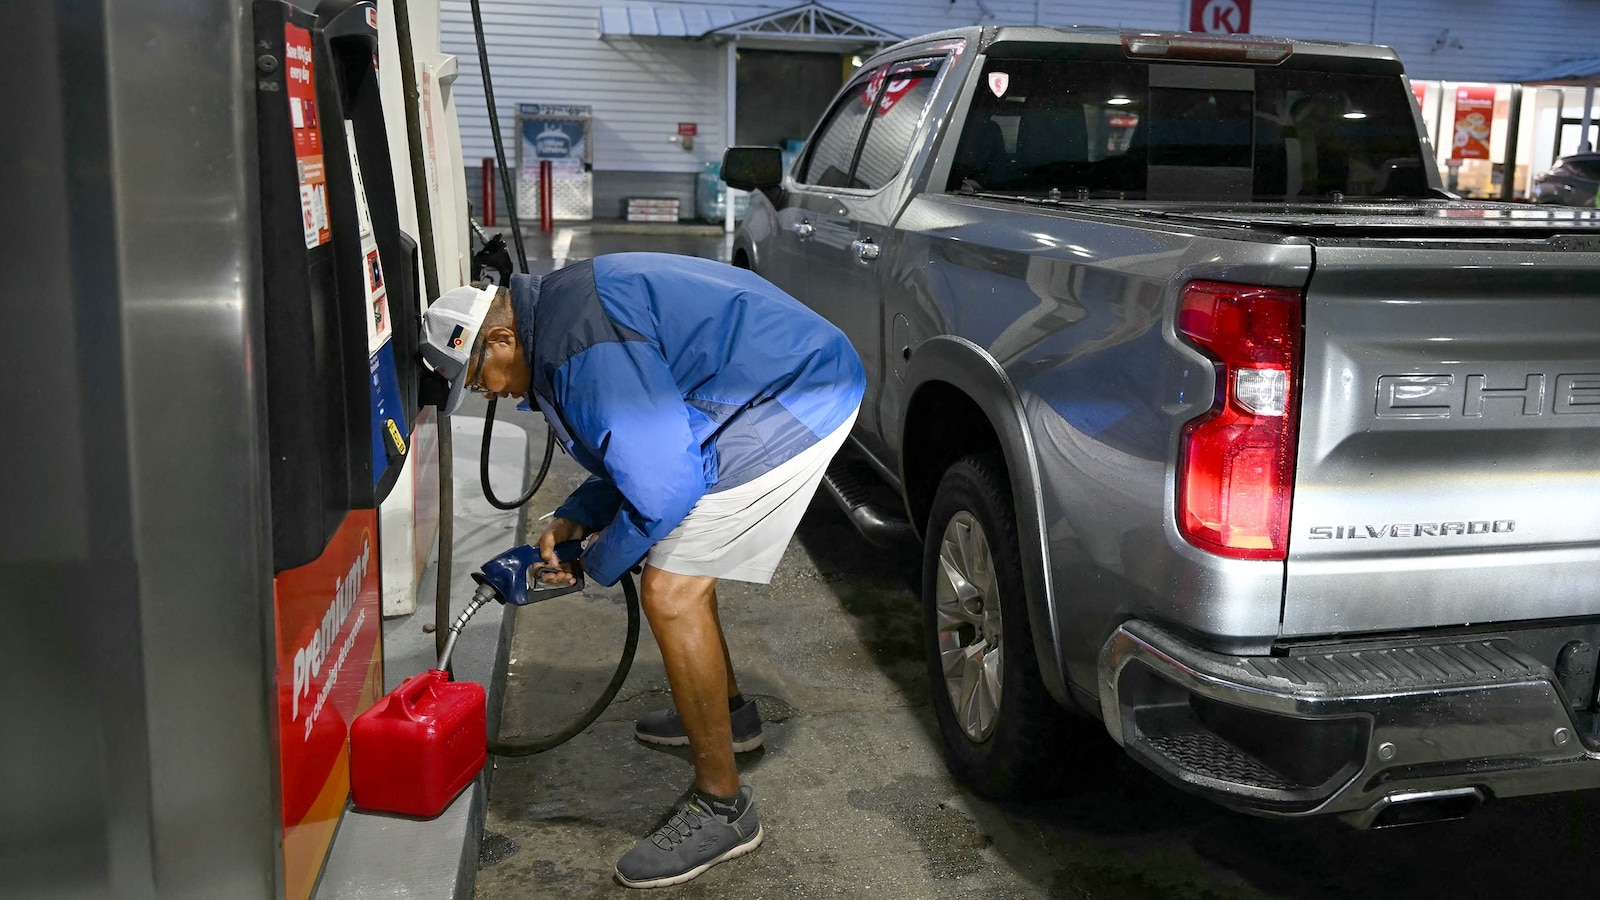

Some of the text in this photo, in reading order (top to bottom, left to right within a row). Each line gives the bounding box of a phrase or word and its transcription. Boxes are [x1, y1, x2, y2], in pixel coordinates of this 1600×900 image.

[1212, 6, 1234, 34] K
[1375, 372, 1600, 419] CHE
[1308, 519, 1516, 540] SILVERADO
